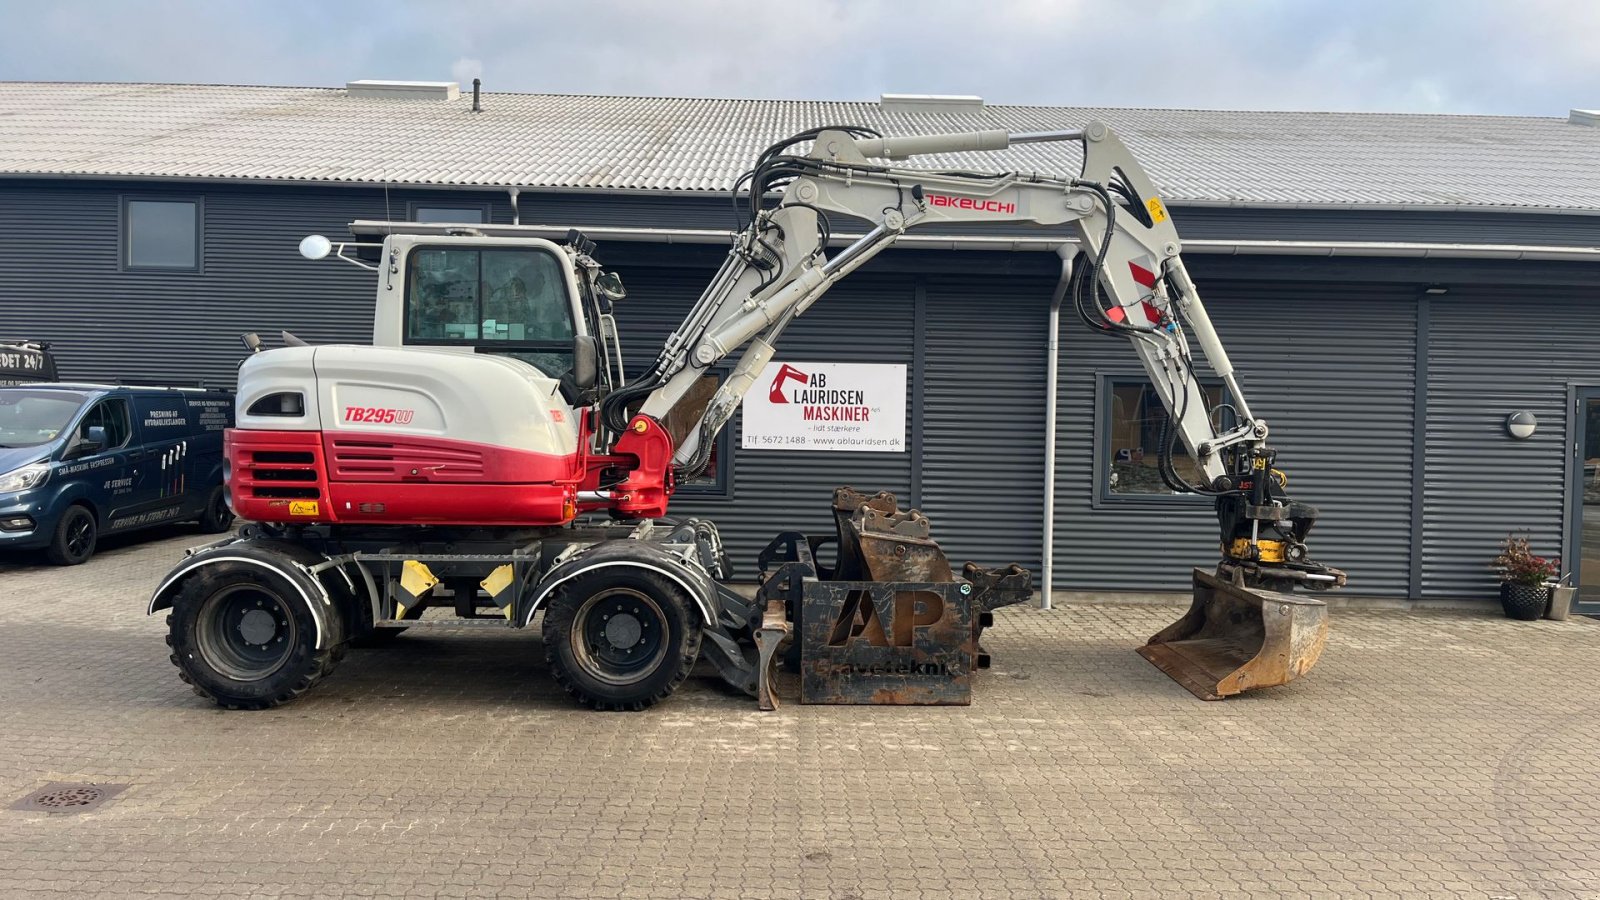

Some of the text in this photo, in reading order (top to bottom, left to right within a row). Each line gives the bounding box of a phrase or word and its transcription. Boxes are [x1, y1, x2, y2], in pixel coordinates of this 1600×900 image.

[925, 194, 1016, 214] TAKEUCHI
[24, 354, 44, 371] 24/7
[809, 373, 826, 388] AB
[793, 389, 864, 405] LAURIDSEN
[344, 407, 415, 424] TB295W
[803, 406, 870, 422] MASKINER
[813, 424, 825, 433] lidt
[827, 425, 861, 433] stærkere
[762, 435, 783, 445] 5672
[785, 436, 806, 445] 1488
[813, 436, 900, 446] www.ablauridsen.dk
[111, 477, 133, 488] SERVICE
[828, 589, 944, 648] AP
